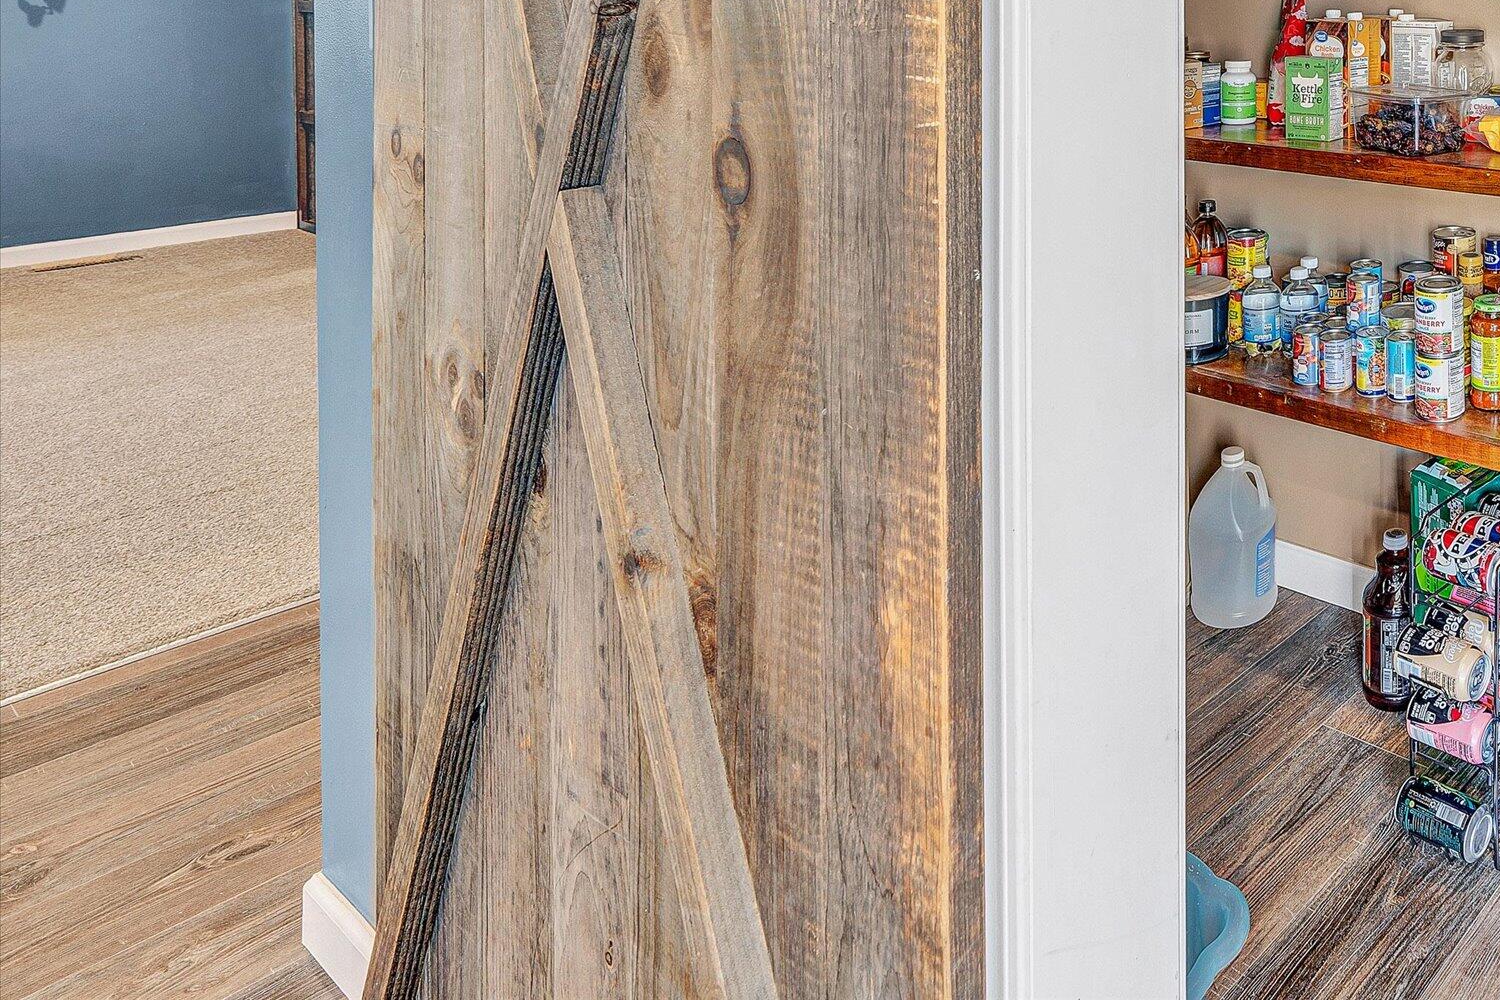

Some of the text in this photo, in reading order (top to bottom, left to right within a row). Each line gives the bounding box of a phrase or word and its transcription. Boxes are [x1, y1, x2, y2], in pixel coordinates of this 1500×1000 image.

[1315, 45, 1340, 54] Chicken
[1292, 84, 1323, 94] Kettle
[1292, 95, 1323, 104] & Fire
[1290, 116, 1324, 126] BONE BROTH
